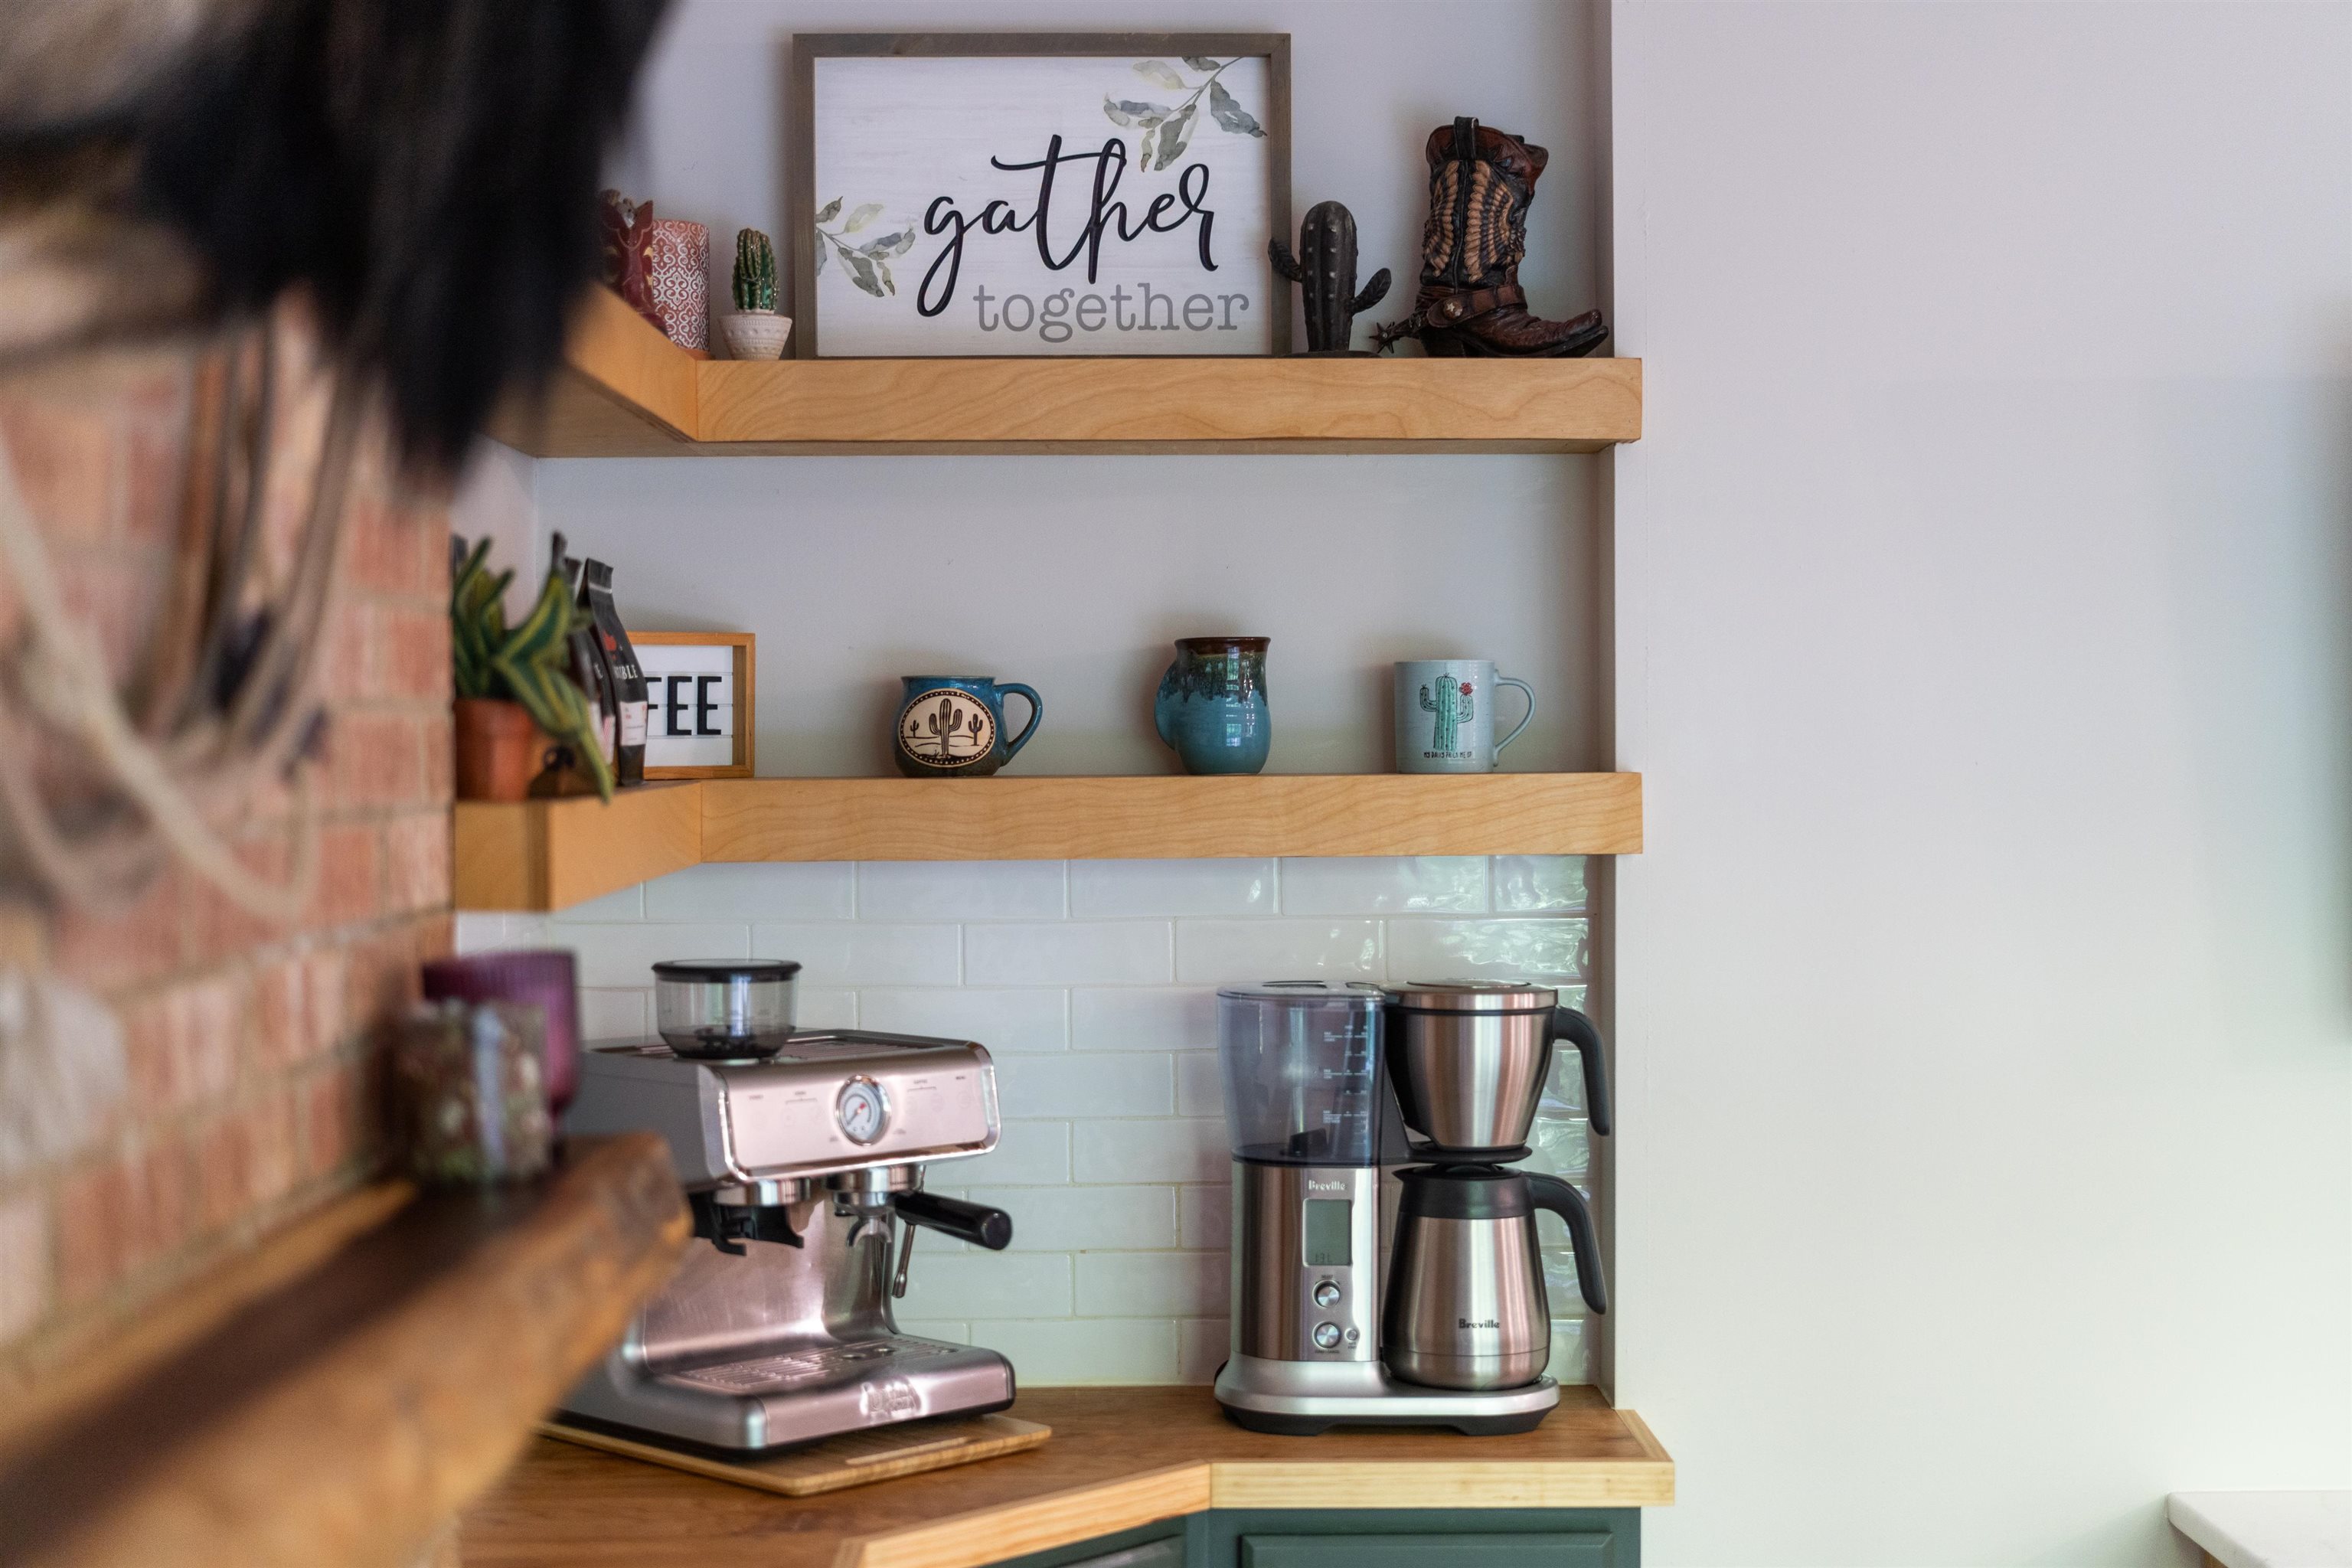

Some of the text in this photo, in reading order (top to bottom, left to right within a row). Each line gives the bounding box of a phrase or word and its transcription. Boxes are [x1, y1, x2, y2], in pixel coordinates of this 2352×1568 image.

[917, 134, 1219, 317] gather
[973, 283, 1250, 343] together
[1308, 1180, 1346, 1191] Breville
[1459, 1318, 1500, 1329] Breville
